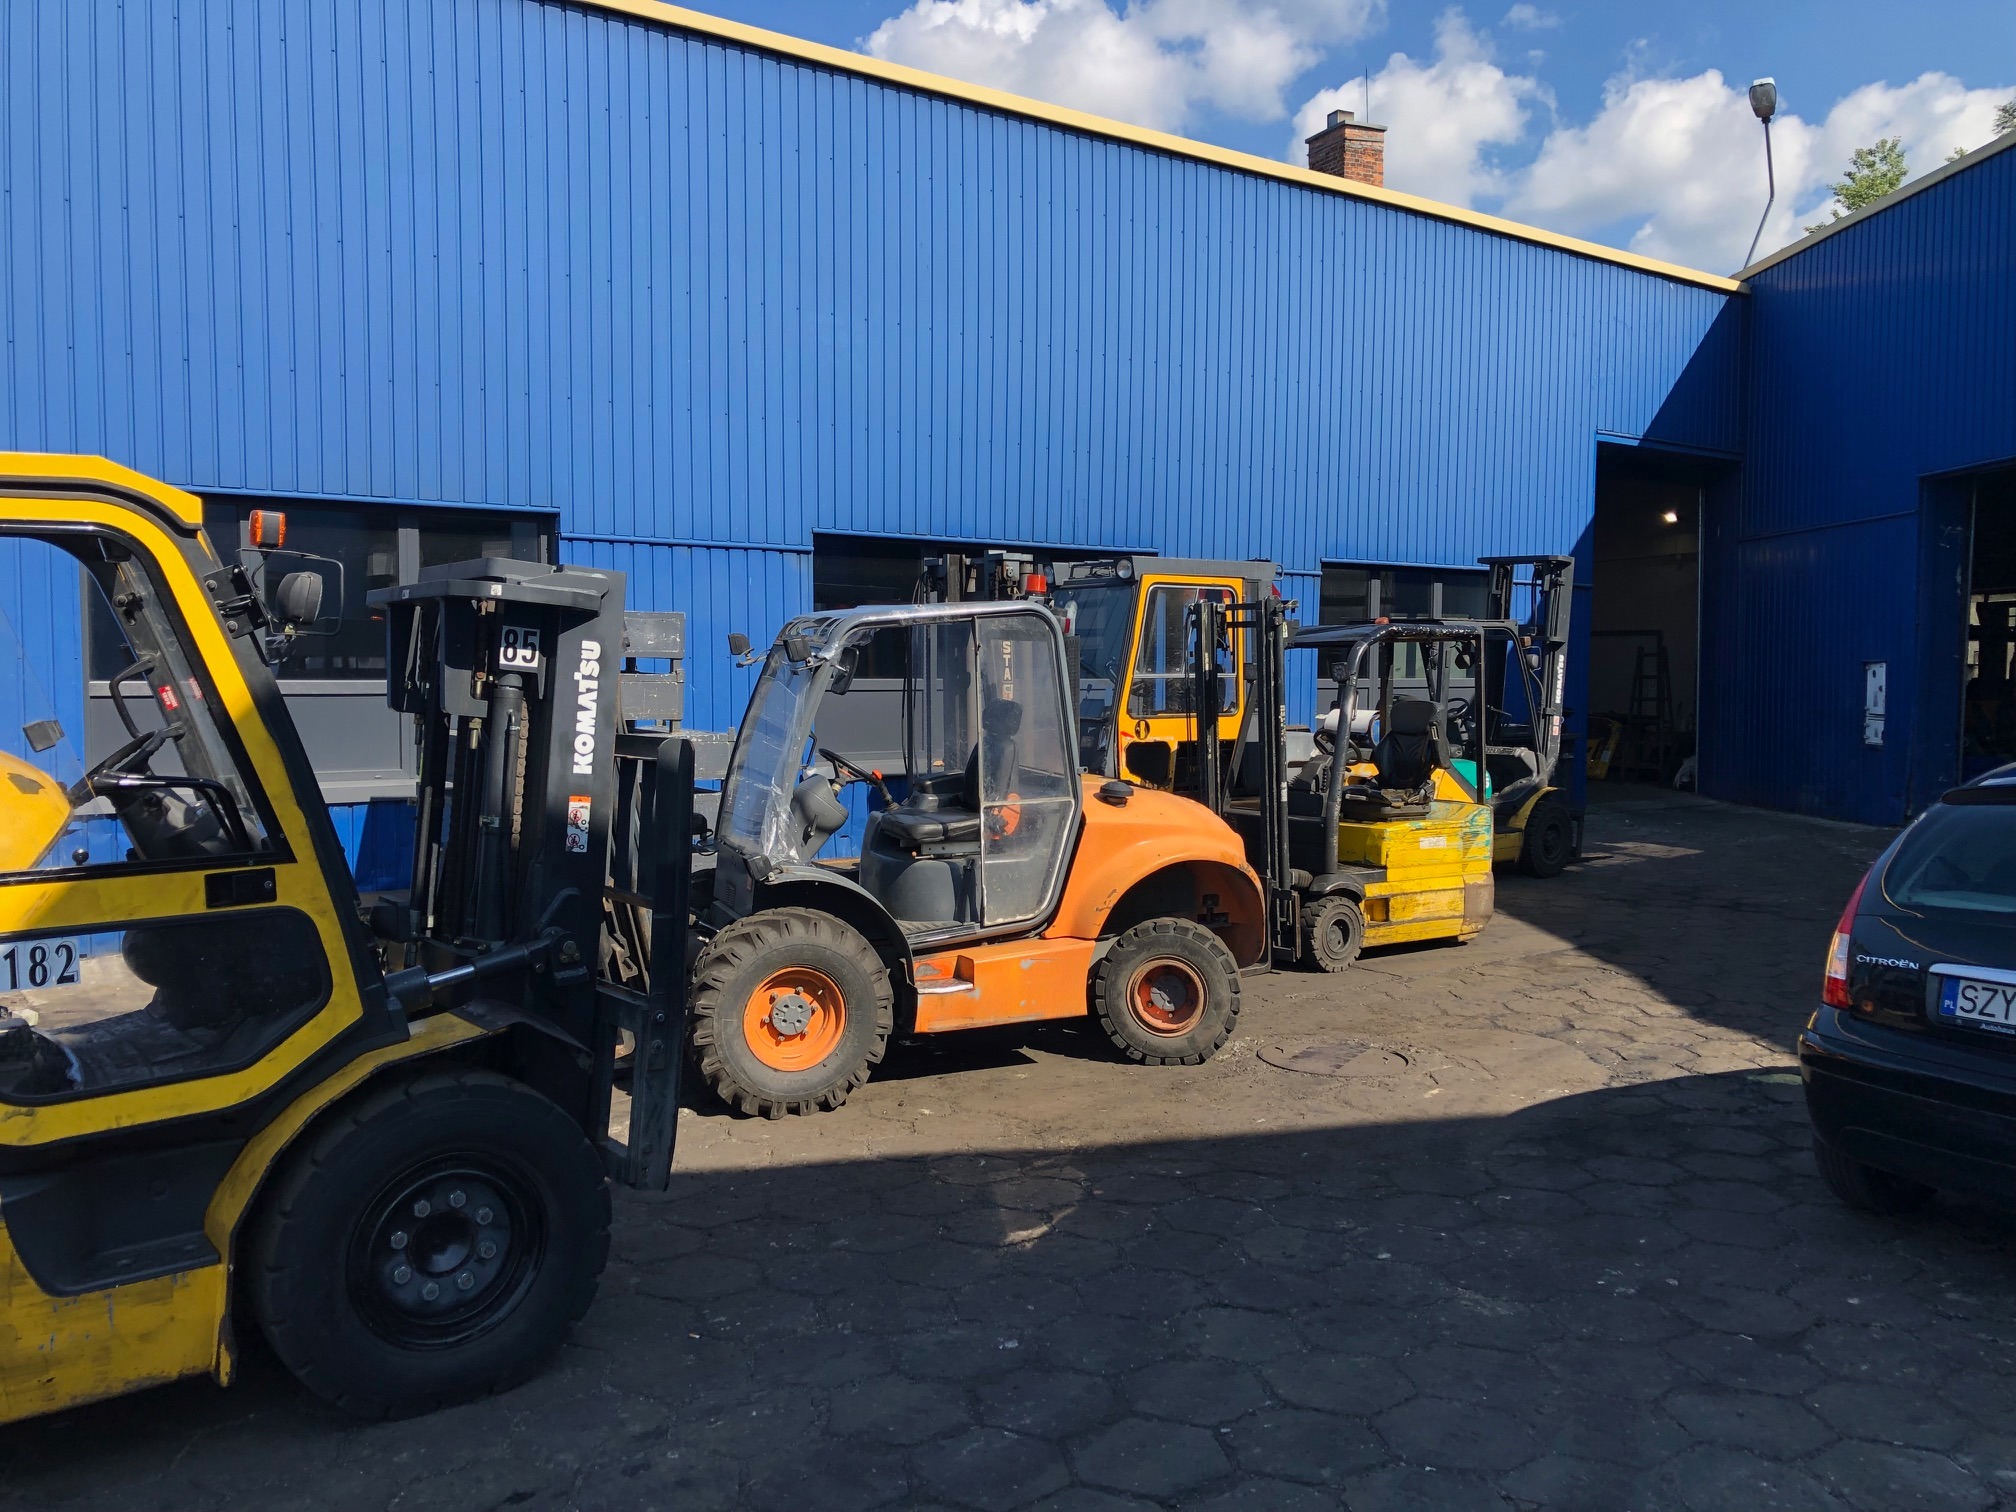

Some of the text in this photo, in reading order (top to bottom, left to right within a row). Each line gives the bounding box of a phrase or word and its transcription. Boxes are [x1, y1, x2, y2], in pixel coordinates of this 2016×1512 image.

[503, 628, 538, 664] 85
[1555, 654, 1565, 704] KOMATSU
[573, 640, 602, 775] KOMATSU
[2, 942, 79, 990] 182
[1856, 954, 1919, 970] CITROËN
[1943, 984, 2016, 1020] PL SZY
